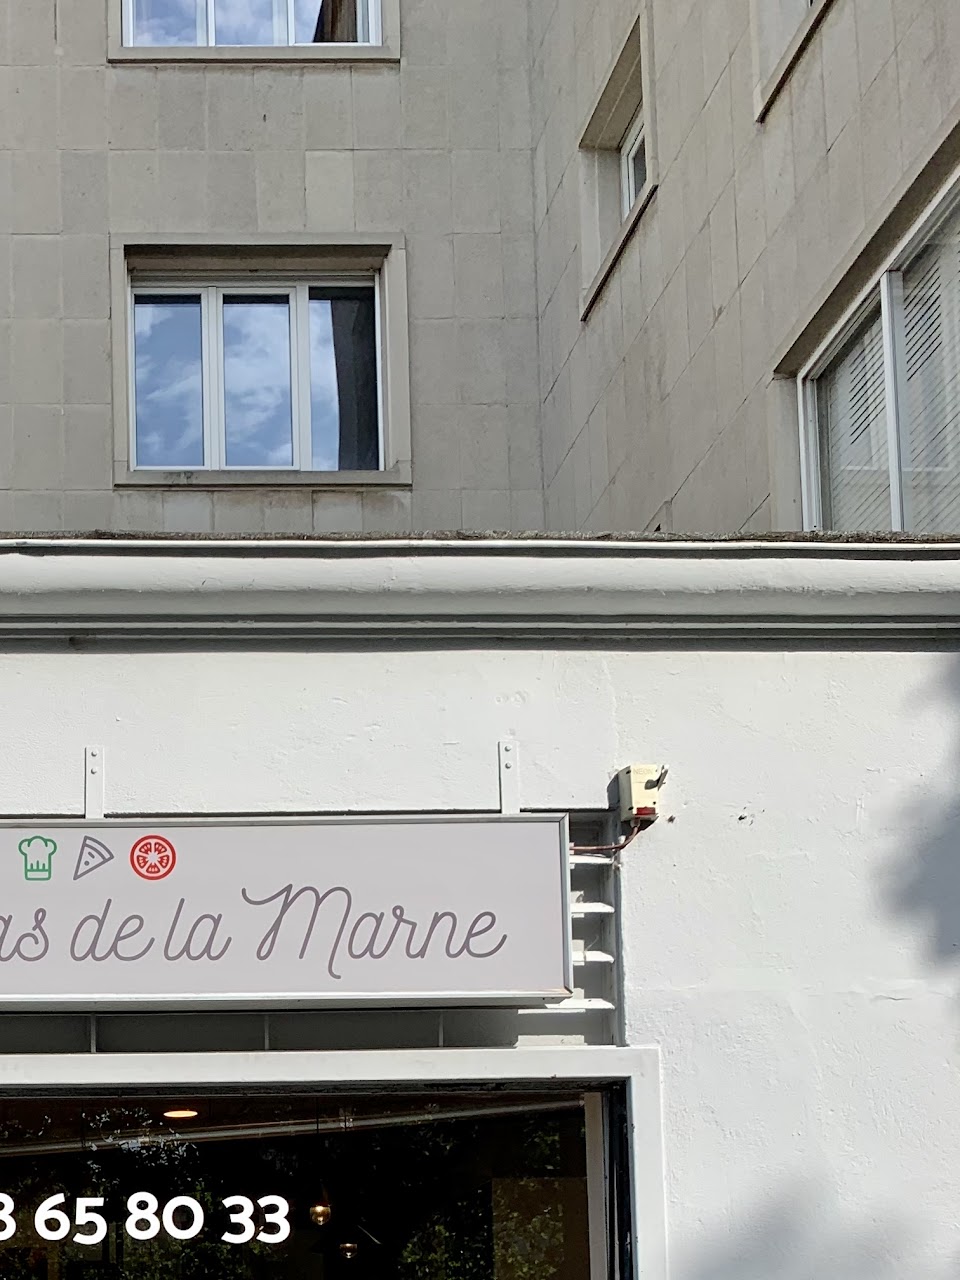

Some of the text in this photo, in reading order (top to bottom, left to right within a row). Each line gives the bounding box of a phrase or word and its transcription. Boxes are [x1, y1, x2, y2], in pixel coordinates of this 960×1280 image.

[70, 899, 155, 961] de
[164, 898, 232, 961] la
[242, 884, 507, 979] Marne
[35, 1193, 107, 1244] 65
[126, 1192, 204, 1239] 80
[222, 1195, 290, 1243] 33
